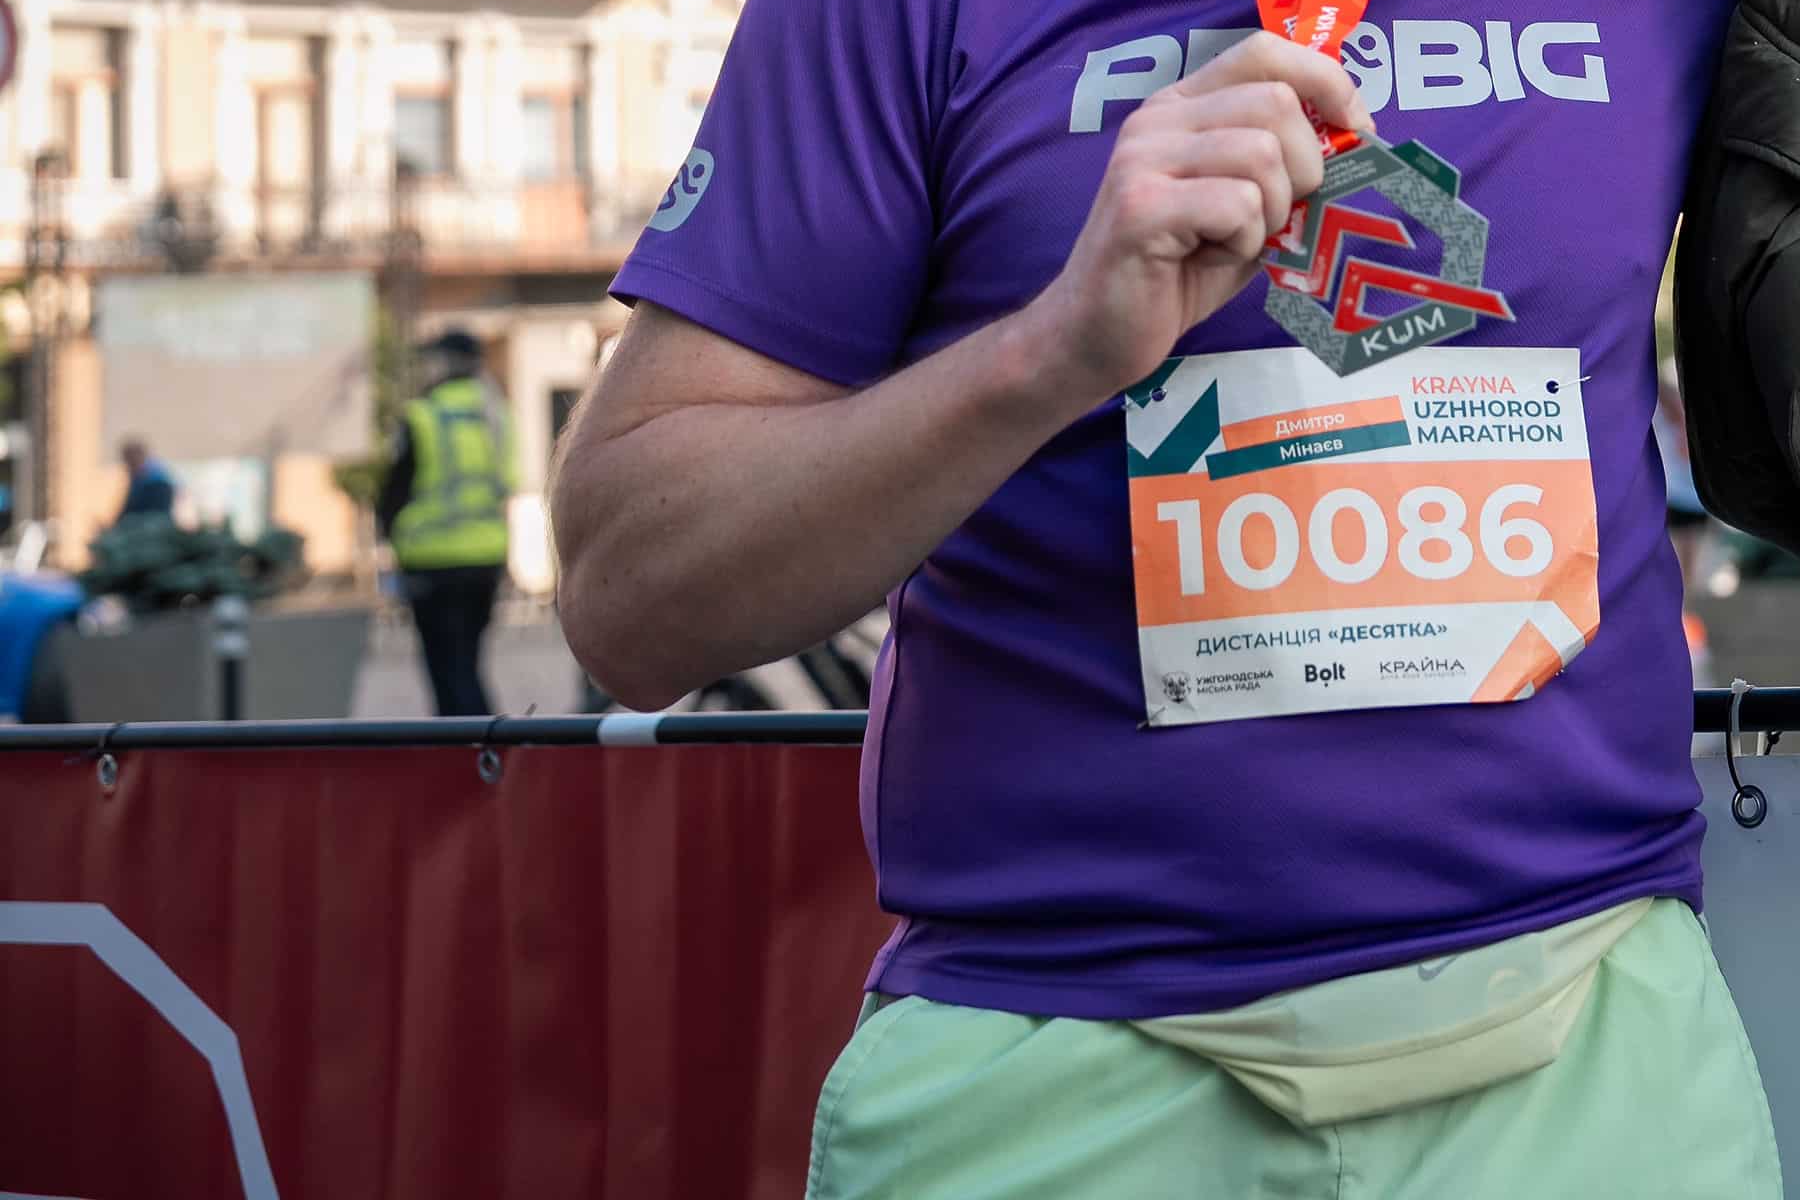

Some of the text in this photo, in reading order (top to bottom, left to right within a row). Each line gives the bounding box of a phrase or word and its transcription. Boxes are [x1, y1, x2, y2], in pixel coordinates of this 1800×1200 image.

[1069, 19, 1610, 133] PBIG
[1360, 308, 1447, 357] KUM
[1411, 376, 1517, 395] KRAYNA
[1414, 400, 1561, 419] UZHHOROD
[1274, 410, 1346, 437] Дмитро
[1417, 424, 1564, 444] MARATHON
[1280, 437, 1344, 460] Мінаєв
[1157, 484, 1554, 596] 10086
[1196, 622, 1448, 656] ДИСТАНЦІЯ «ДЕСЯТКА»
[1379, 656, 1465, 674] КРАЙНА
[1196, 670, 1274, 685] УЖГОРОДСЬКА
[1197, 681, 1261, 694] МІСЬКА РАДА
